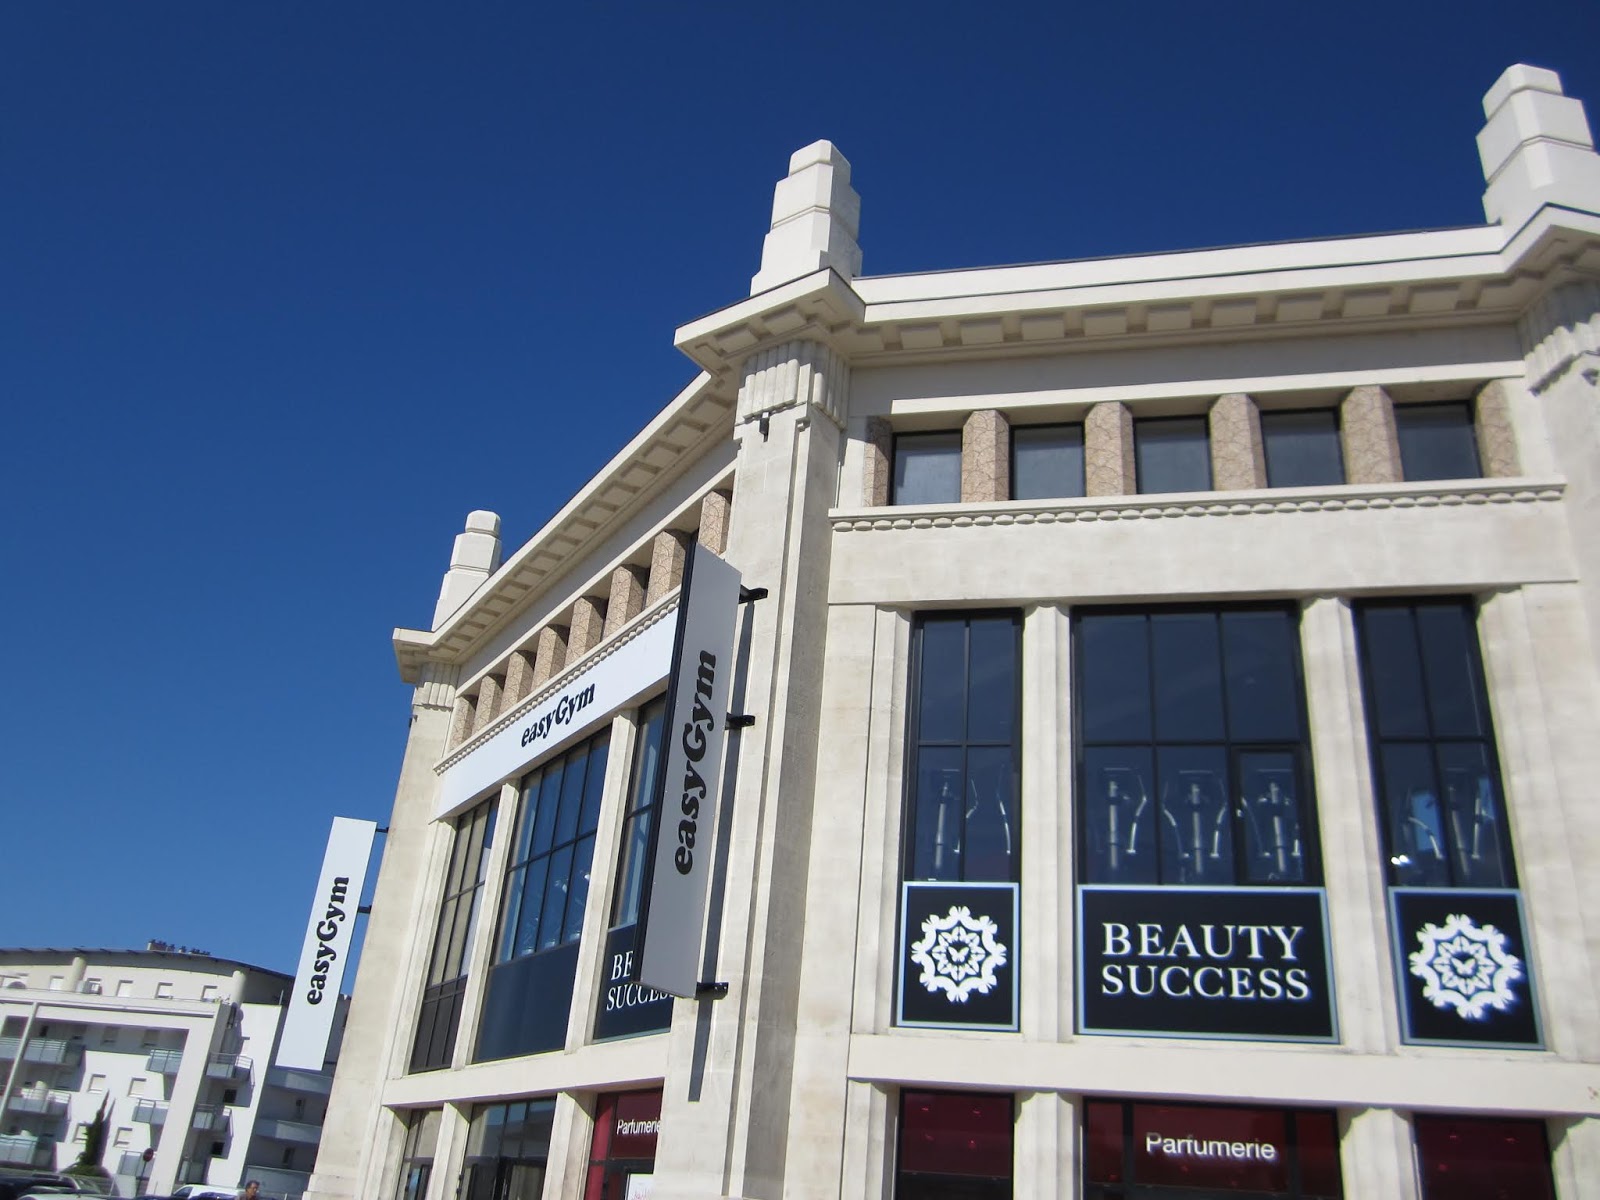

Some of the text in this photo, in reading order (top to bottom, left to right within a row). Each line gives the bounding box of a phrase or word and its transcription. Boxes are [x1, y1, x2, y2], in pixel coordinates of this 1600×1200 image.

[521, 683, 596, 748] easyGym
[675, 650, 716, 875] easyGym
[307, 876, 349, 1005] easyGym
[1101, 922, 1304, 960] BEAUTY
[606, 983, 674, 1011] SUCC
[1101, 964, 1311, 1000] SUCCESS
[1145, 1132, 1277, 1160] Parfumerie
